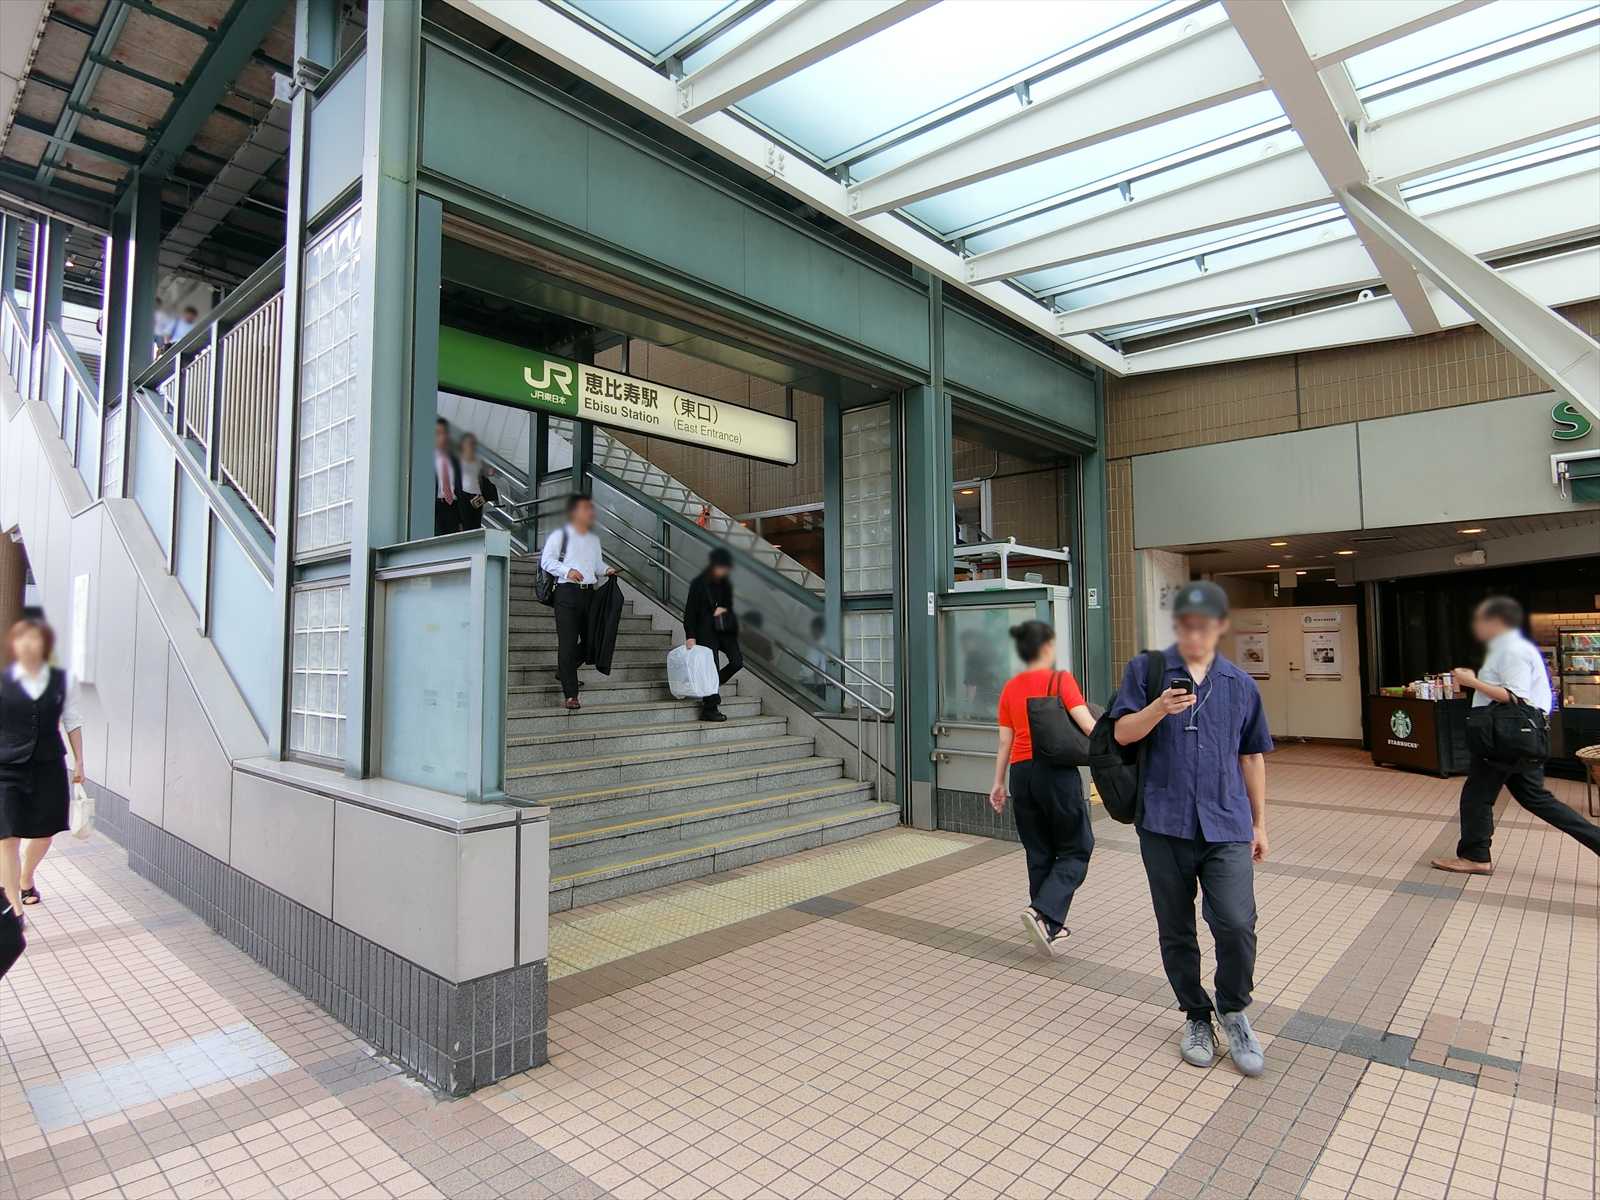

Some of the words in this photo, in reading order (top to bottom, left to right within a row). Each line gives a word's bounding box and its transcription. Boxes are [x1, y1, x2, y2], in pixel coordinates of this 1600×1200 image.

[524, 360, 573, 397] JR
[530, 389, 567, 405] JR東日本
[584, 372, 658, 410] 恵比寿駅
[584, 397, 617, 416] Ebisu
[621, 405, 660, 425] Station
[673, 417, 698, 435] (East
[700, 424, 742, 445] Entrance)
[1387, 739, 1419, 749] STARBUCKS
